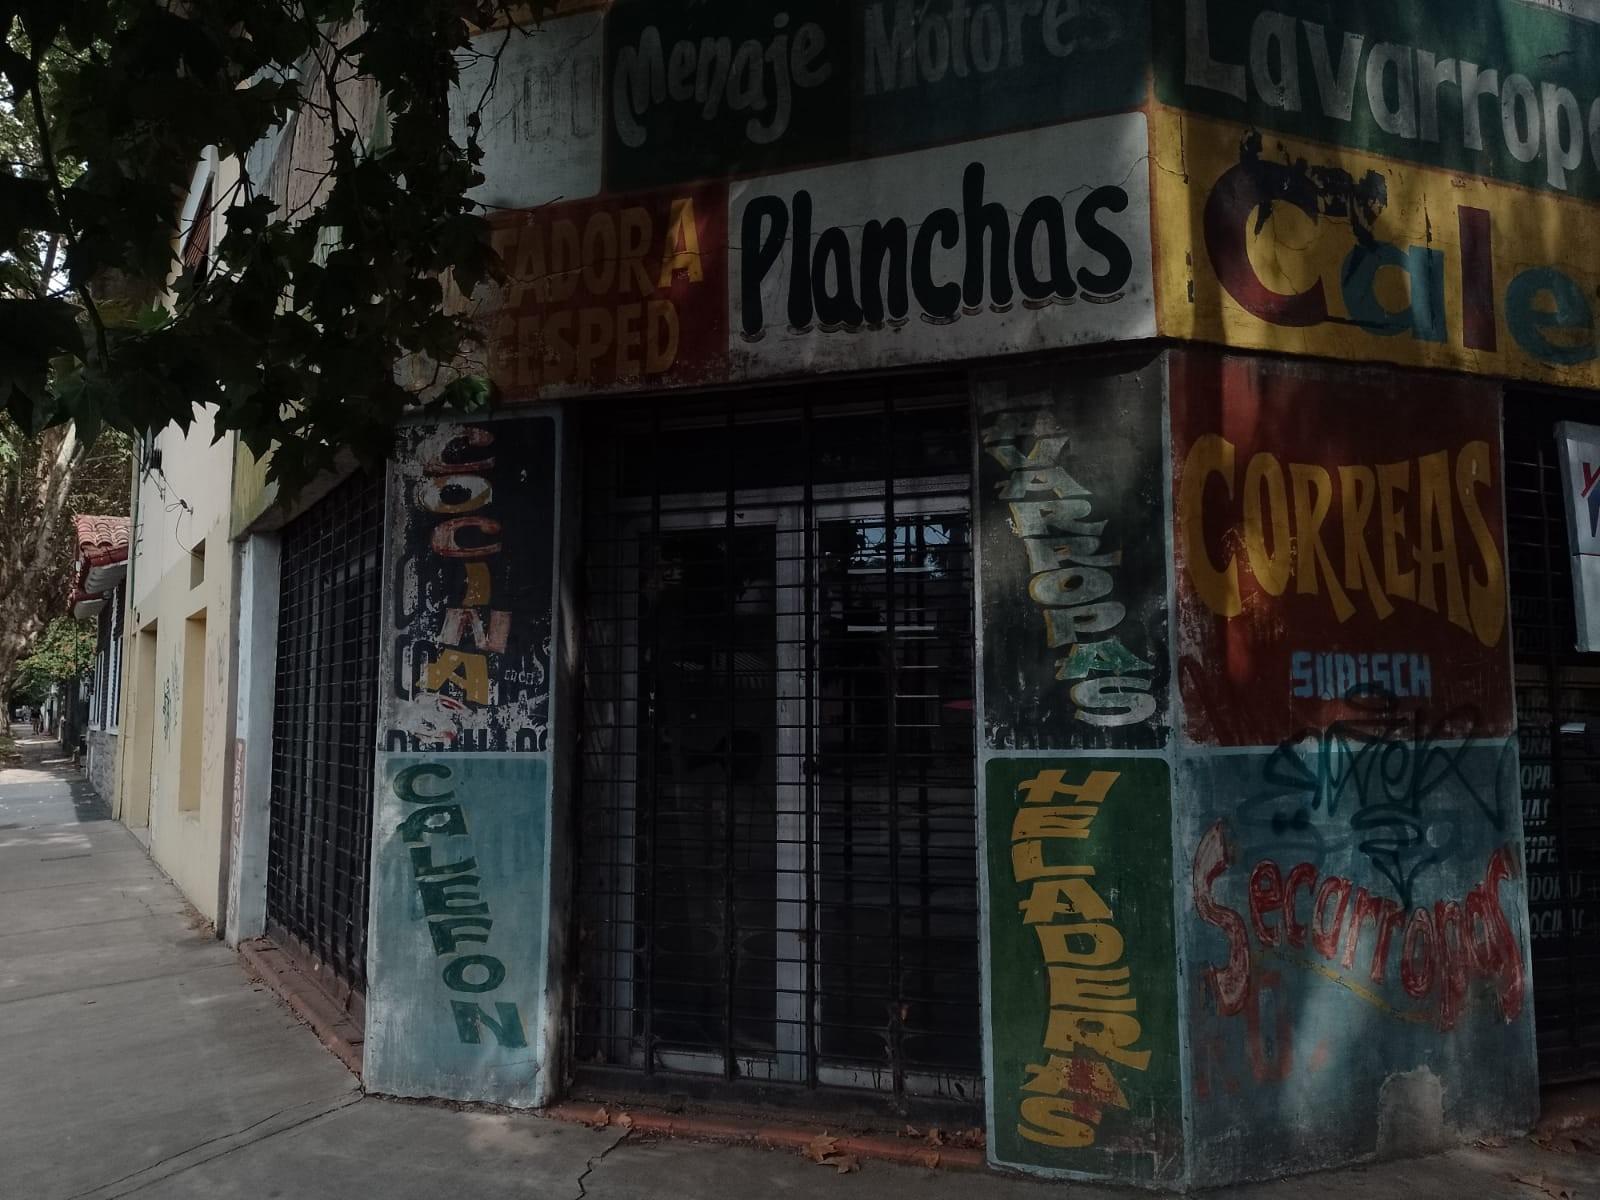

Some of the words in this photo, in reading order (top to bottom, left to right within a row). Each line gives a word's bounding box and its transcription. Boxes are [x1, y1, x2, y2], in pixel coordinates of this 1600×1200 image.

[1184, 0, 1600, 190] Lavarrop
[490, 196, 705, 305] TADORA
[741, 162, 1133, 338] Planchas
[1179, 432, 1508, 649] CORREAS
[1010, 768, 1153, 1149] HELADERAS
